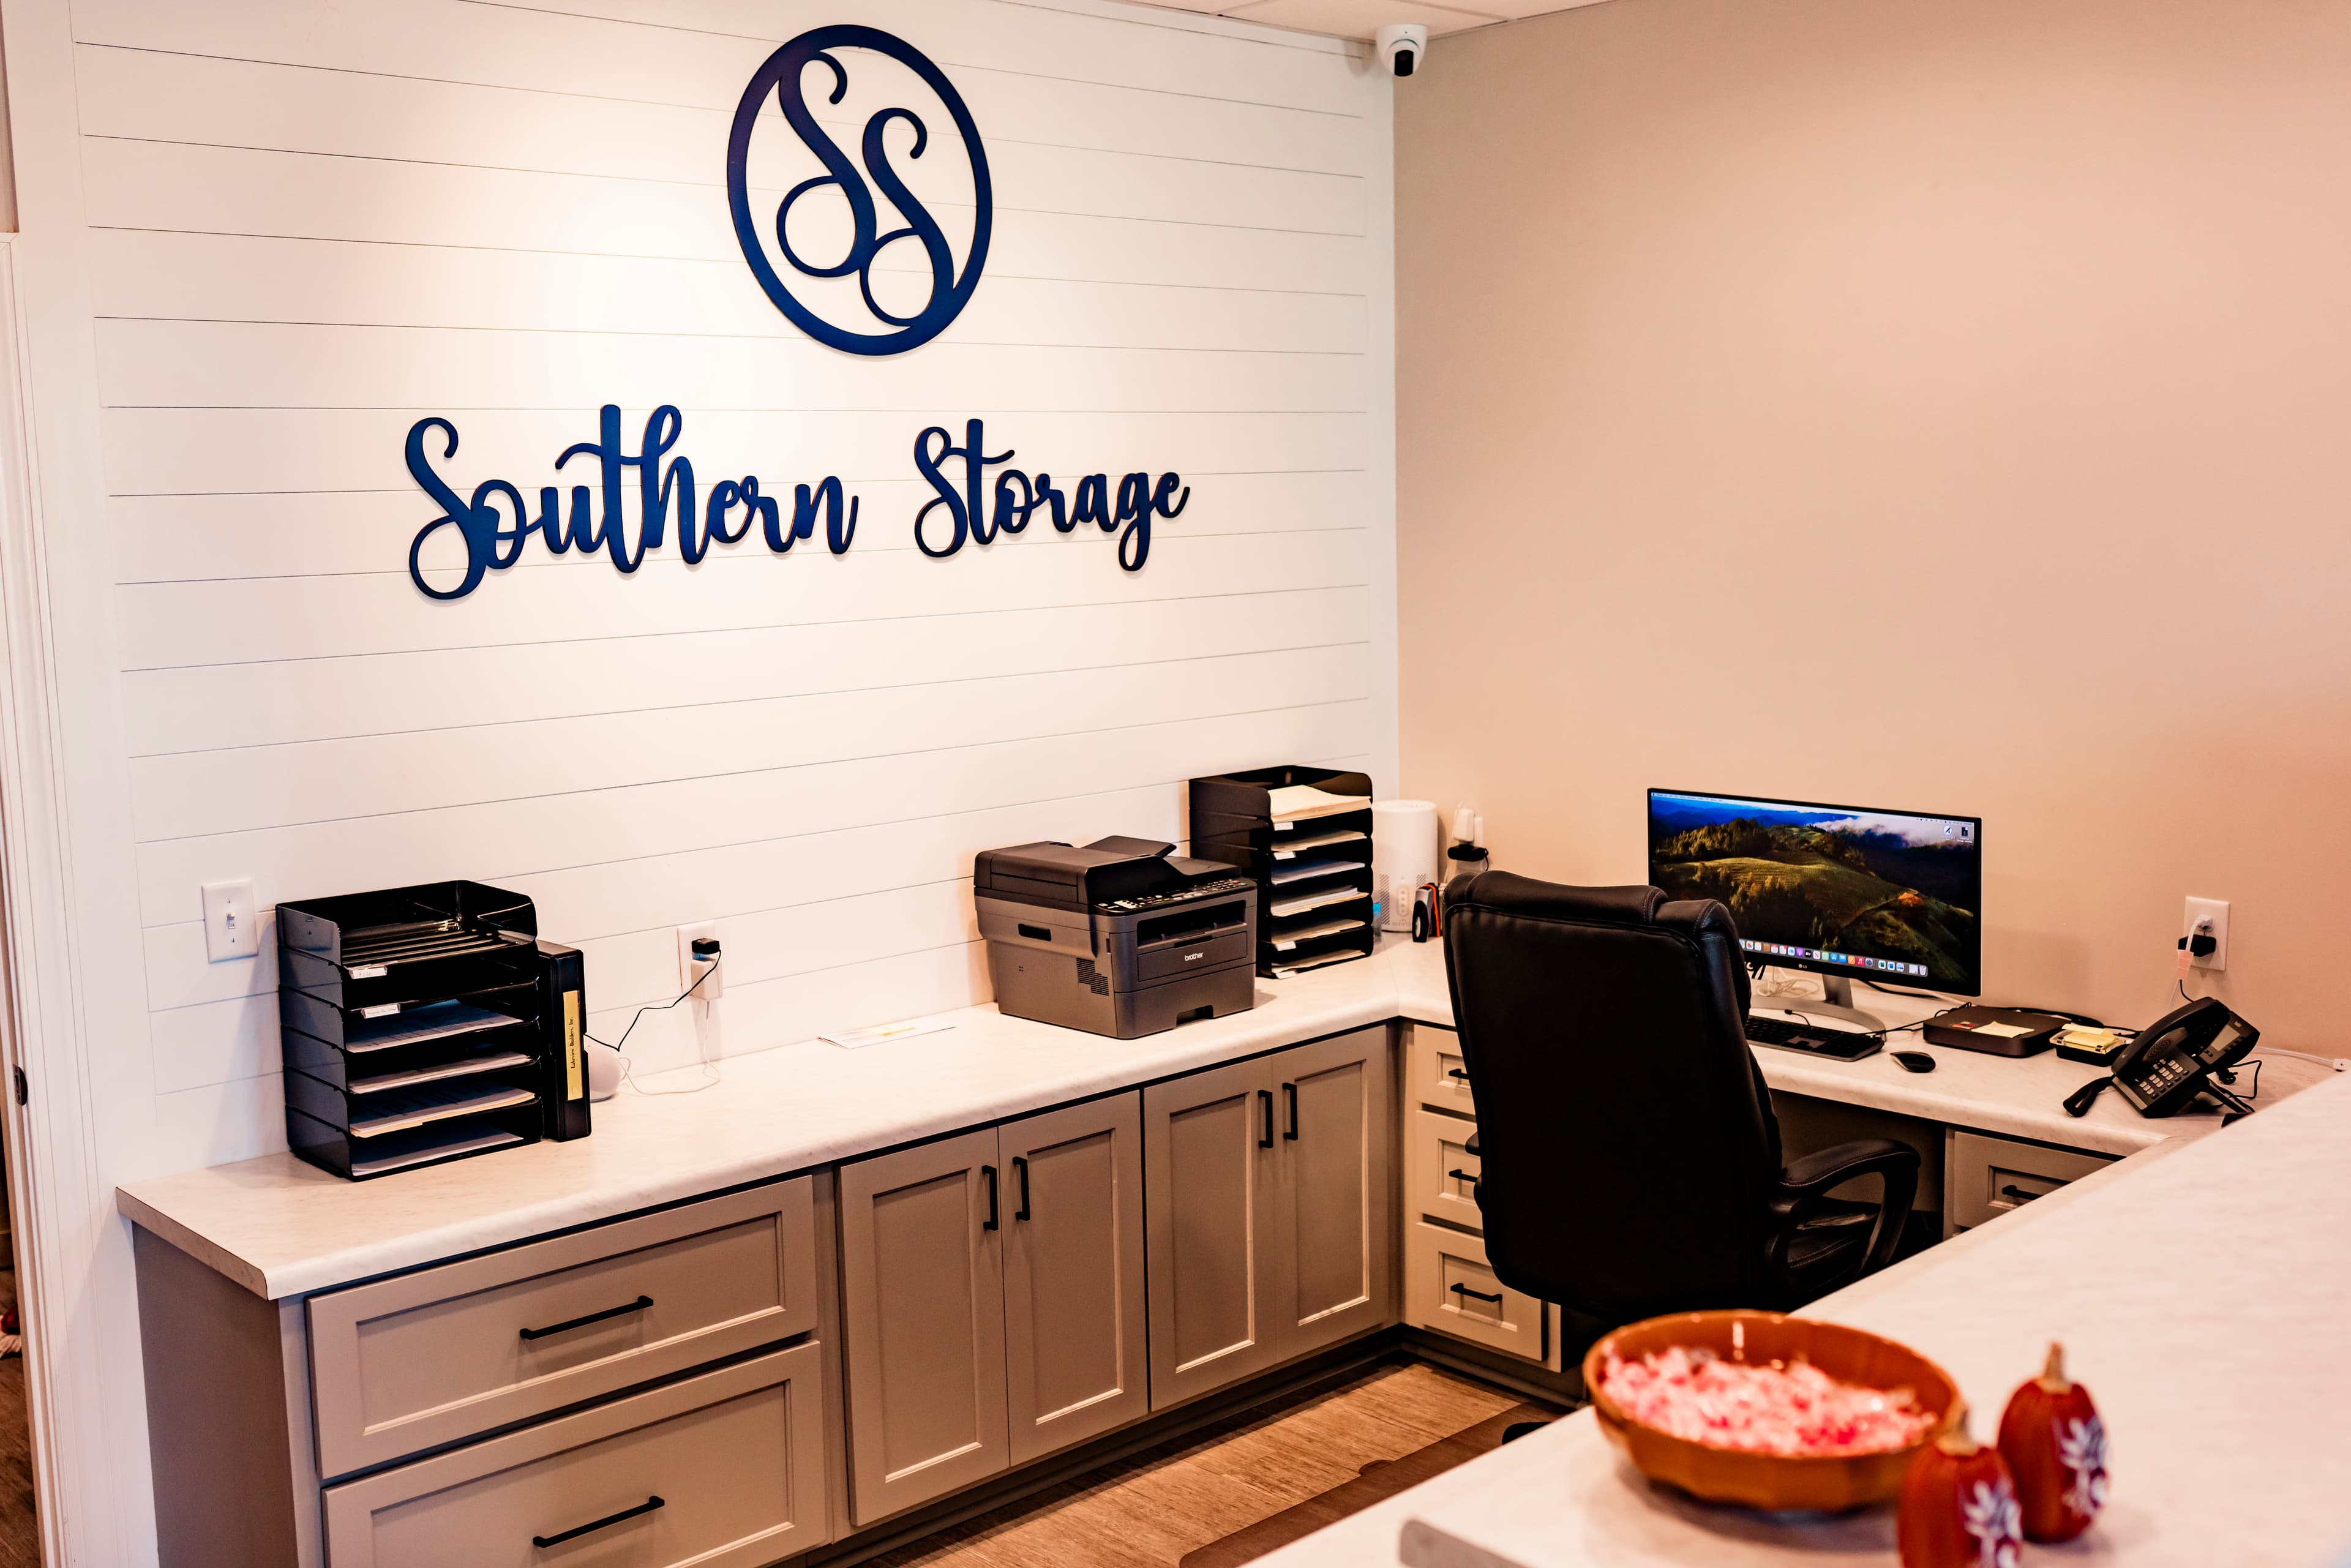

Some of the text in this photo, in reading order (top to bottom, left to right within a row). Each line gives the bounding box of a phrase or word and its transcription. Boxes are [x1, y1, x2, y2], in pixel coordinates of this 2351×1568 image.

[405, 404, 1191, 601] Southern Storage
[1185, 952, 1204, 961] brother
